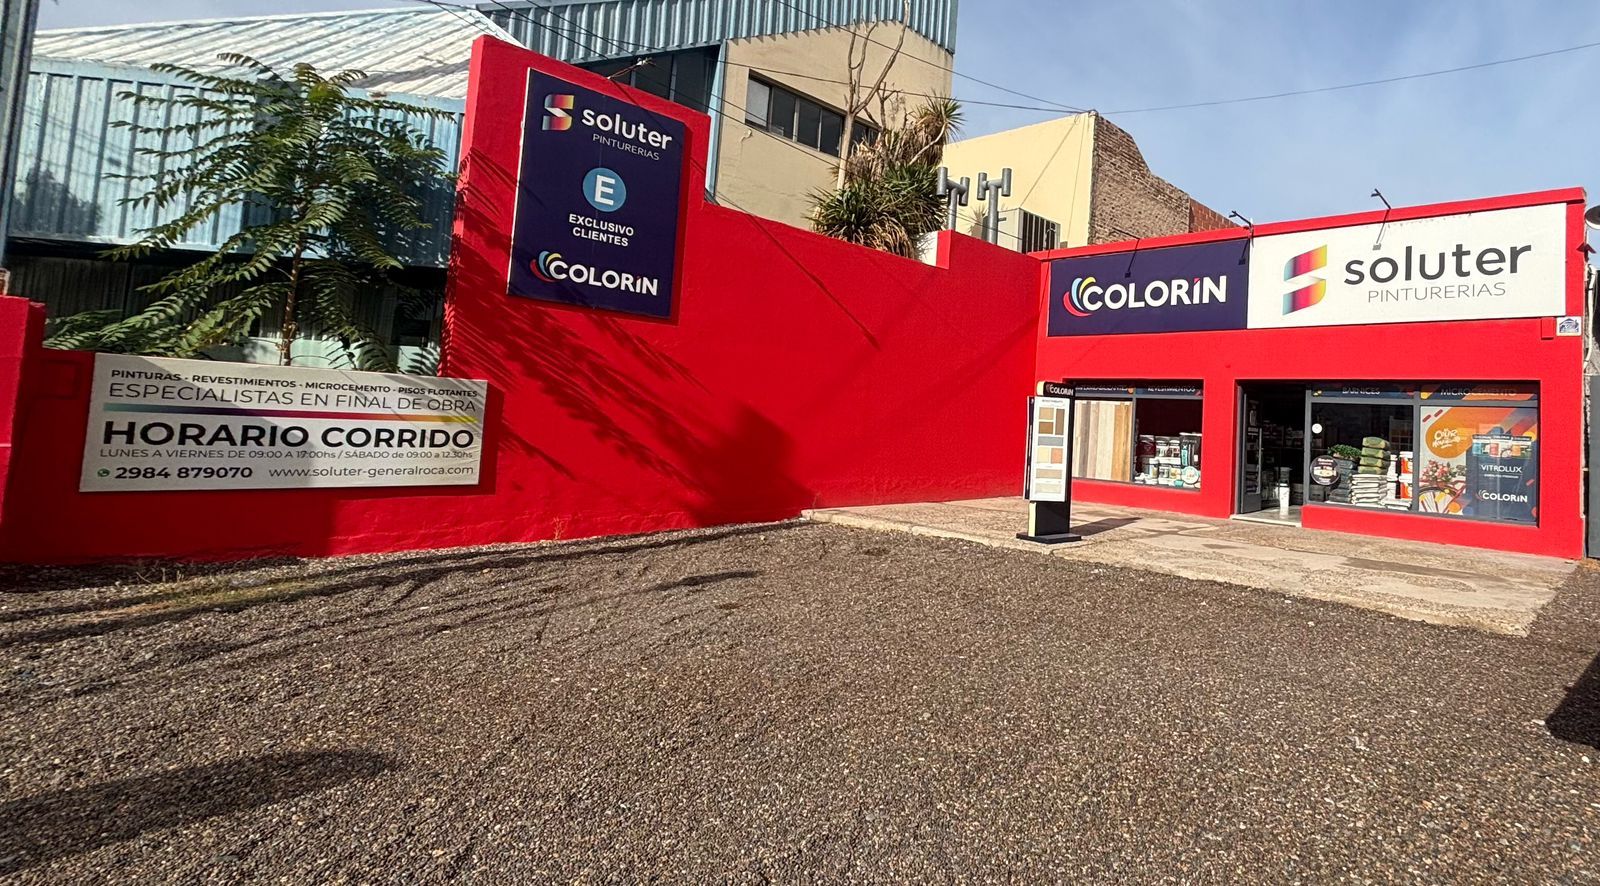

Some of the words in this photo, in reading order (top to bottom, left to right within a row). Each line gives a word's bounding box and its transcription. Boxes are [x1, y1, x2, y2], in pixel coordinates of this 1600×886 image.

[581, 108, 672, 150] soluter
[593, 133, 660, 161] PINTURERIAS
[594, 174, 616, 206] E
[568, 213, 634, 237] EXCLUSIVO
[572, 227, 629, 247] CLIENTES
[1343, 243, 1532, 286] soluter
[1367, 281, 1506, 303] PINTURERIAS
[109, 382, 294, 405] ESPECIALISTAS
[301, 392, 329, 407] EN
[335, 394, 392, 409] FINAL
[397, 397, 422, 410] DE
[427, 398, 476, 412] OBRA
[111, 369, 182, 382] PINTURAS
[192, 374, 297, 388] REVESTIMIENTOS
[305, 382, 391, 394] MICROCEMENTO
[398, 387, 426, 396] PISOS
[427, 388, 478, 398] FLOTANTES
[103, 420, 309, 447] HORARIO
[321, 427, 474, 448] CORRIDO
[100, 449, 149, 458] LUNES
[151, 449, 162, 458] A
[165, 449, 224, 459] VIERNES
[227, 450, 246, 459] DE
[284, 450, 293, 459] A
[344, 449, 389, 459] SÁBADO
[391, 450, 404, 459] de
[115, 467, 171, 479] 2984
[177, 467, 253, 479] 879070
[268, 465, 474, 479] www.soluter-generalroca.com
[1480, 464, 1522, 473] VITROLUX
